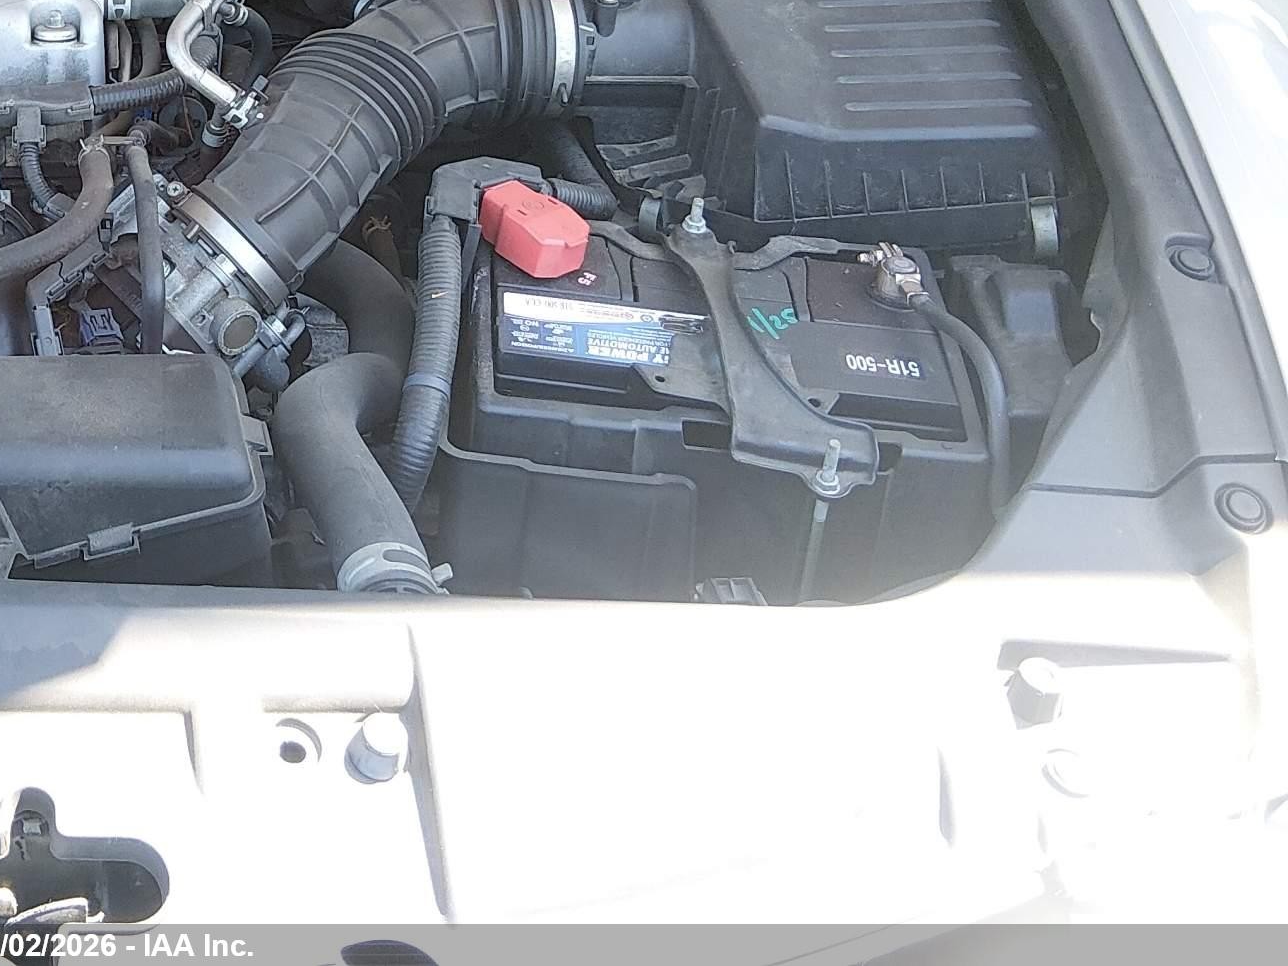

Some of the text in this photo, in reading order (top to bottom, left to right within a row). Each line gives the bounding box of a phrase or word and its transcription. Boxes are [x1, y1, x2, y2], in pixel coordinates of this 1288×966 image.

[587, 338, 657, 353] AUTOMOTIVE
[587, 345, 649, 362] POWER
[845, 353, 920, 377] 51R-500
